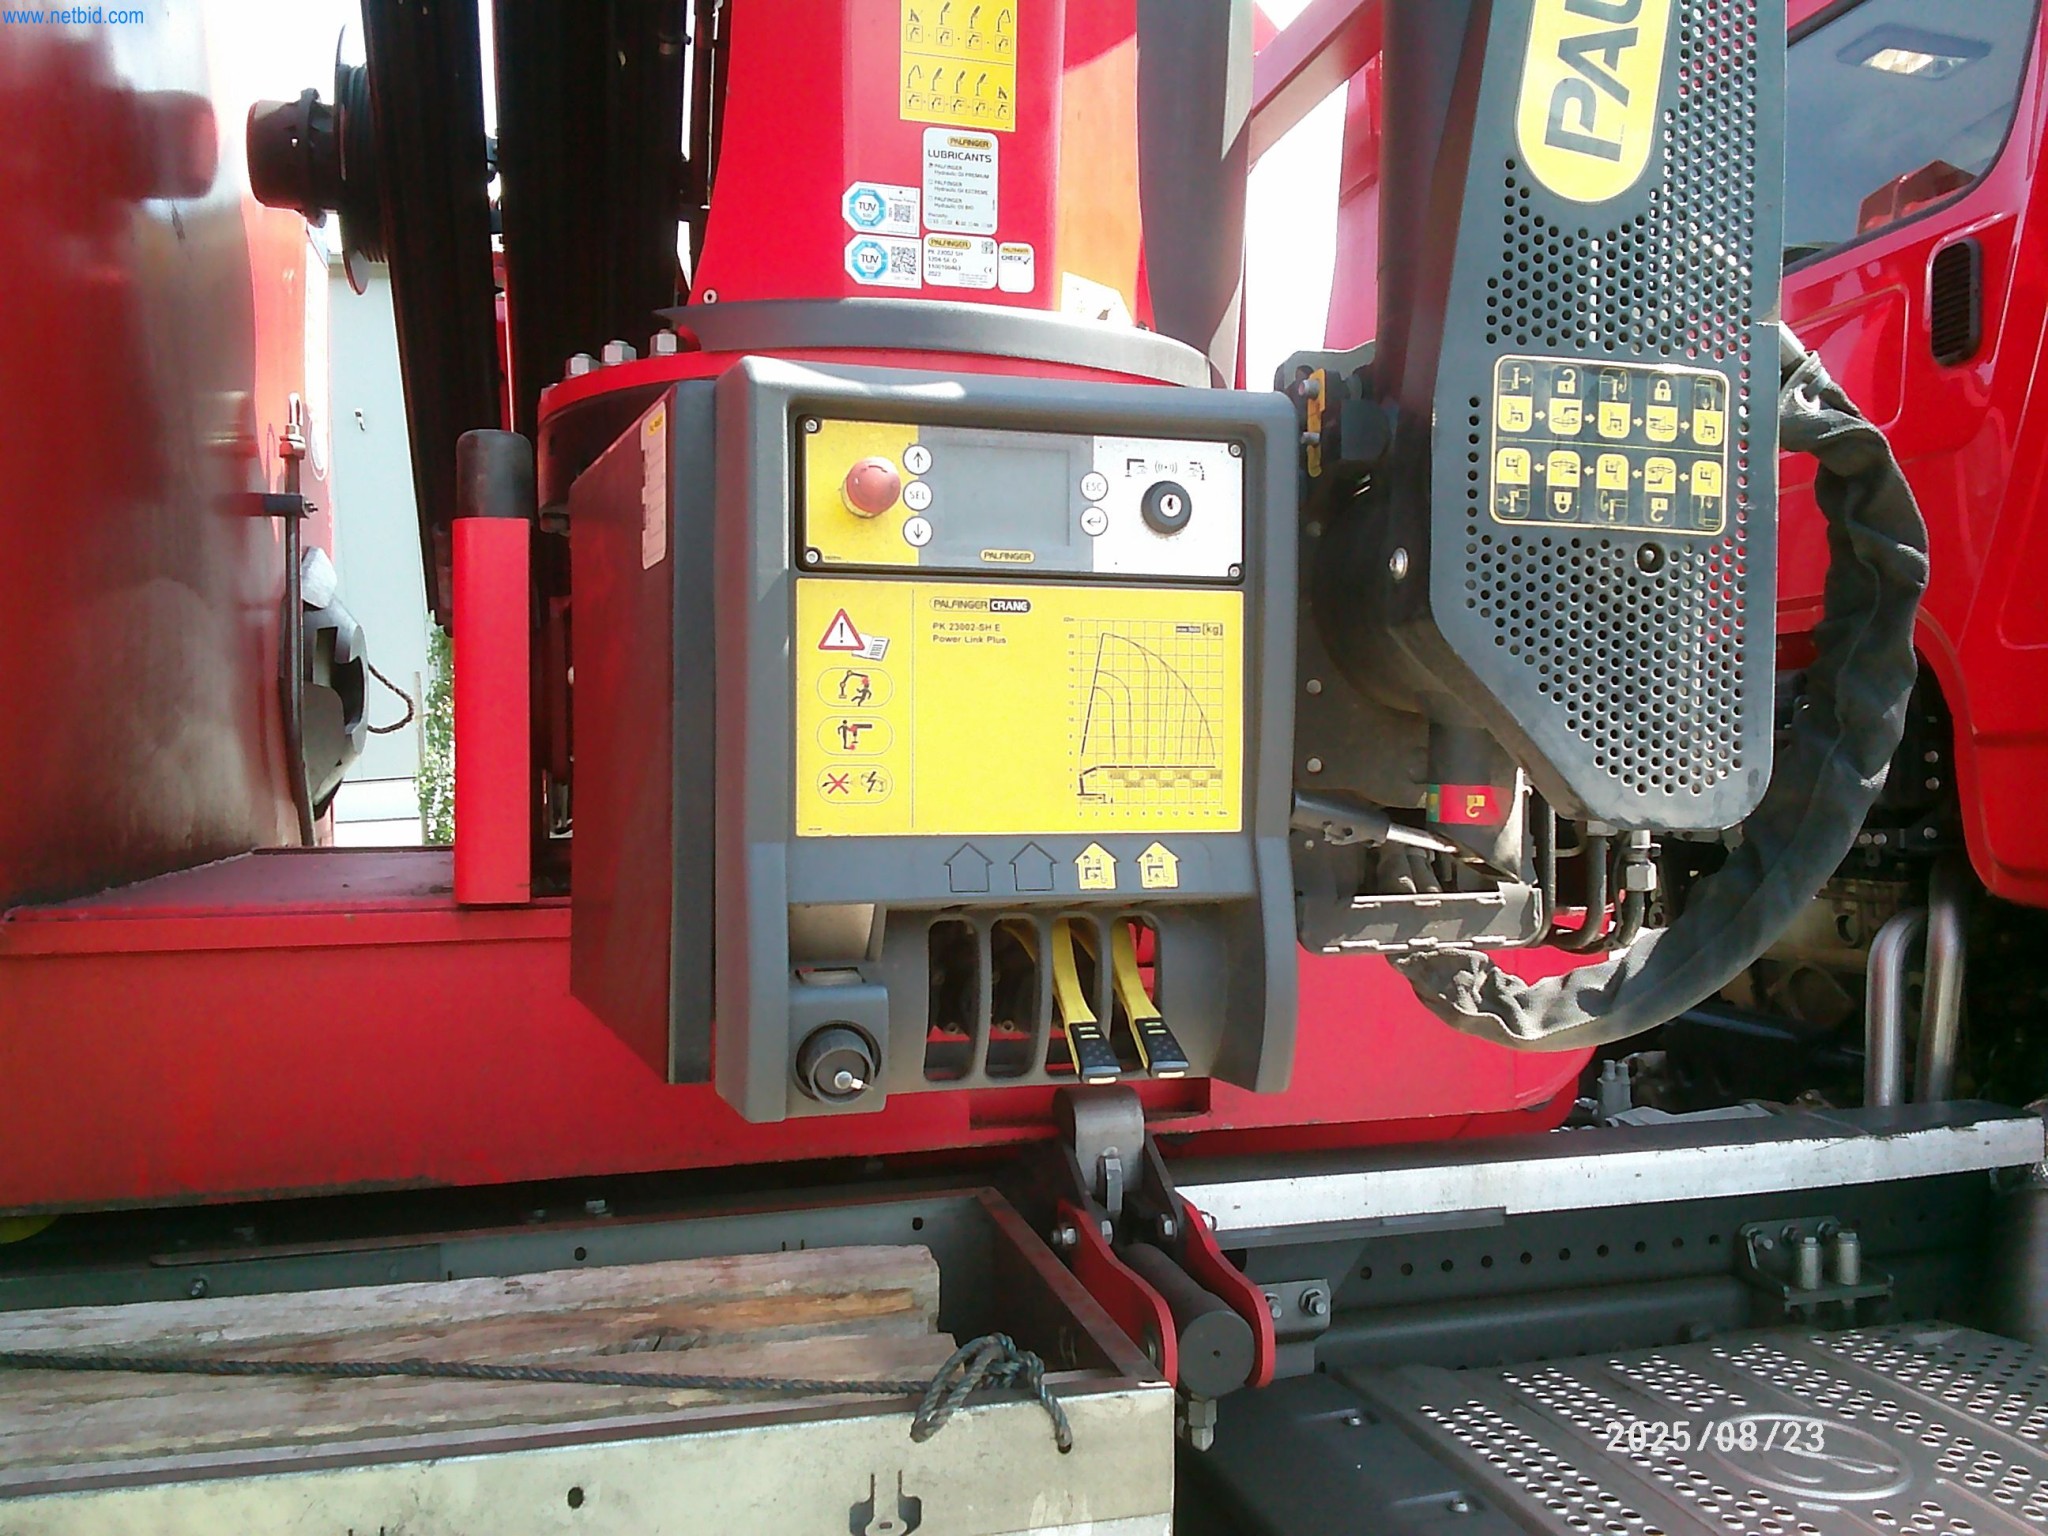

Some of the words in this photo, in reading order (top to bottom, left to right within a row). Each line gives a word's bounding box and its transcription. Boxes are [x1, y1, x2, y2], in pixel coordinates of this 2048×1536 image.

[949, 137, 990, 148] PALFINGER
[928, 149, 992, 163] LUBRICANTS
[930, 239, 970, 249] PALFINGER
[1086, 482, 1103, 492] ESC
[910, 490, 926, 501] SEL
[983, 551, 1031, 562] PALFINGER
[933, 600, 988, 609] PALFINGER
[990, 601, 1028, 611] CRANE
[932, 623, 946, 631] PK
[994, 624, 1001, 632] E
[932, 635, 961, 643] Power
[986, 636, 1006, 644] Plus
